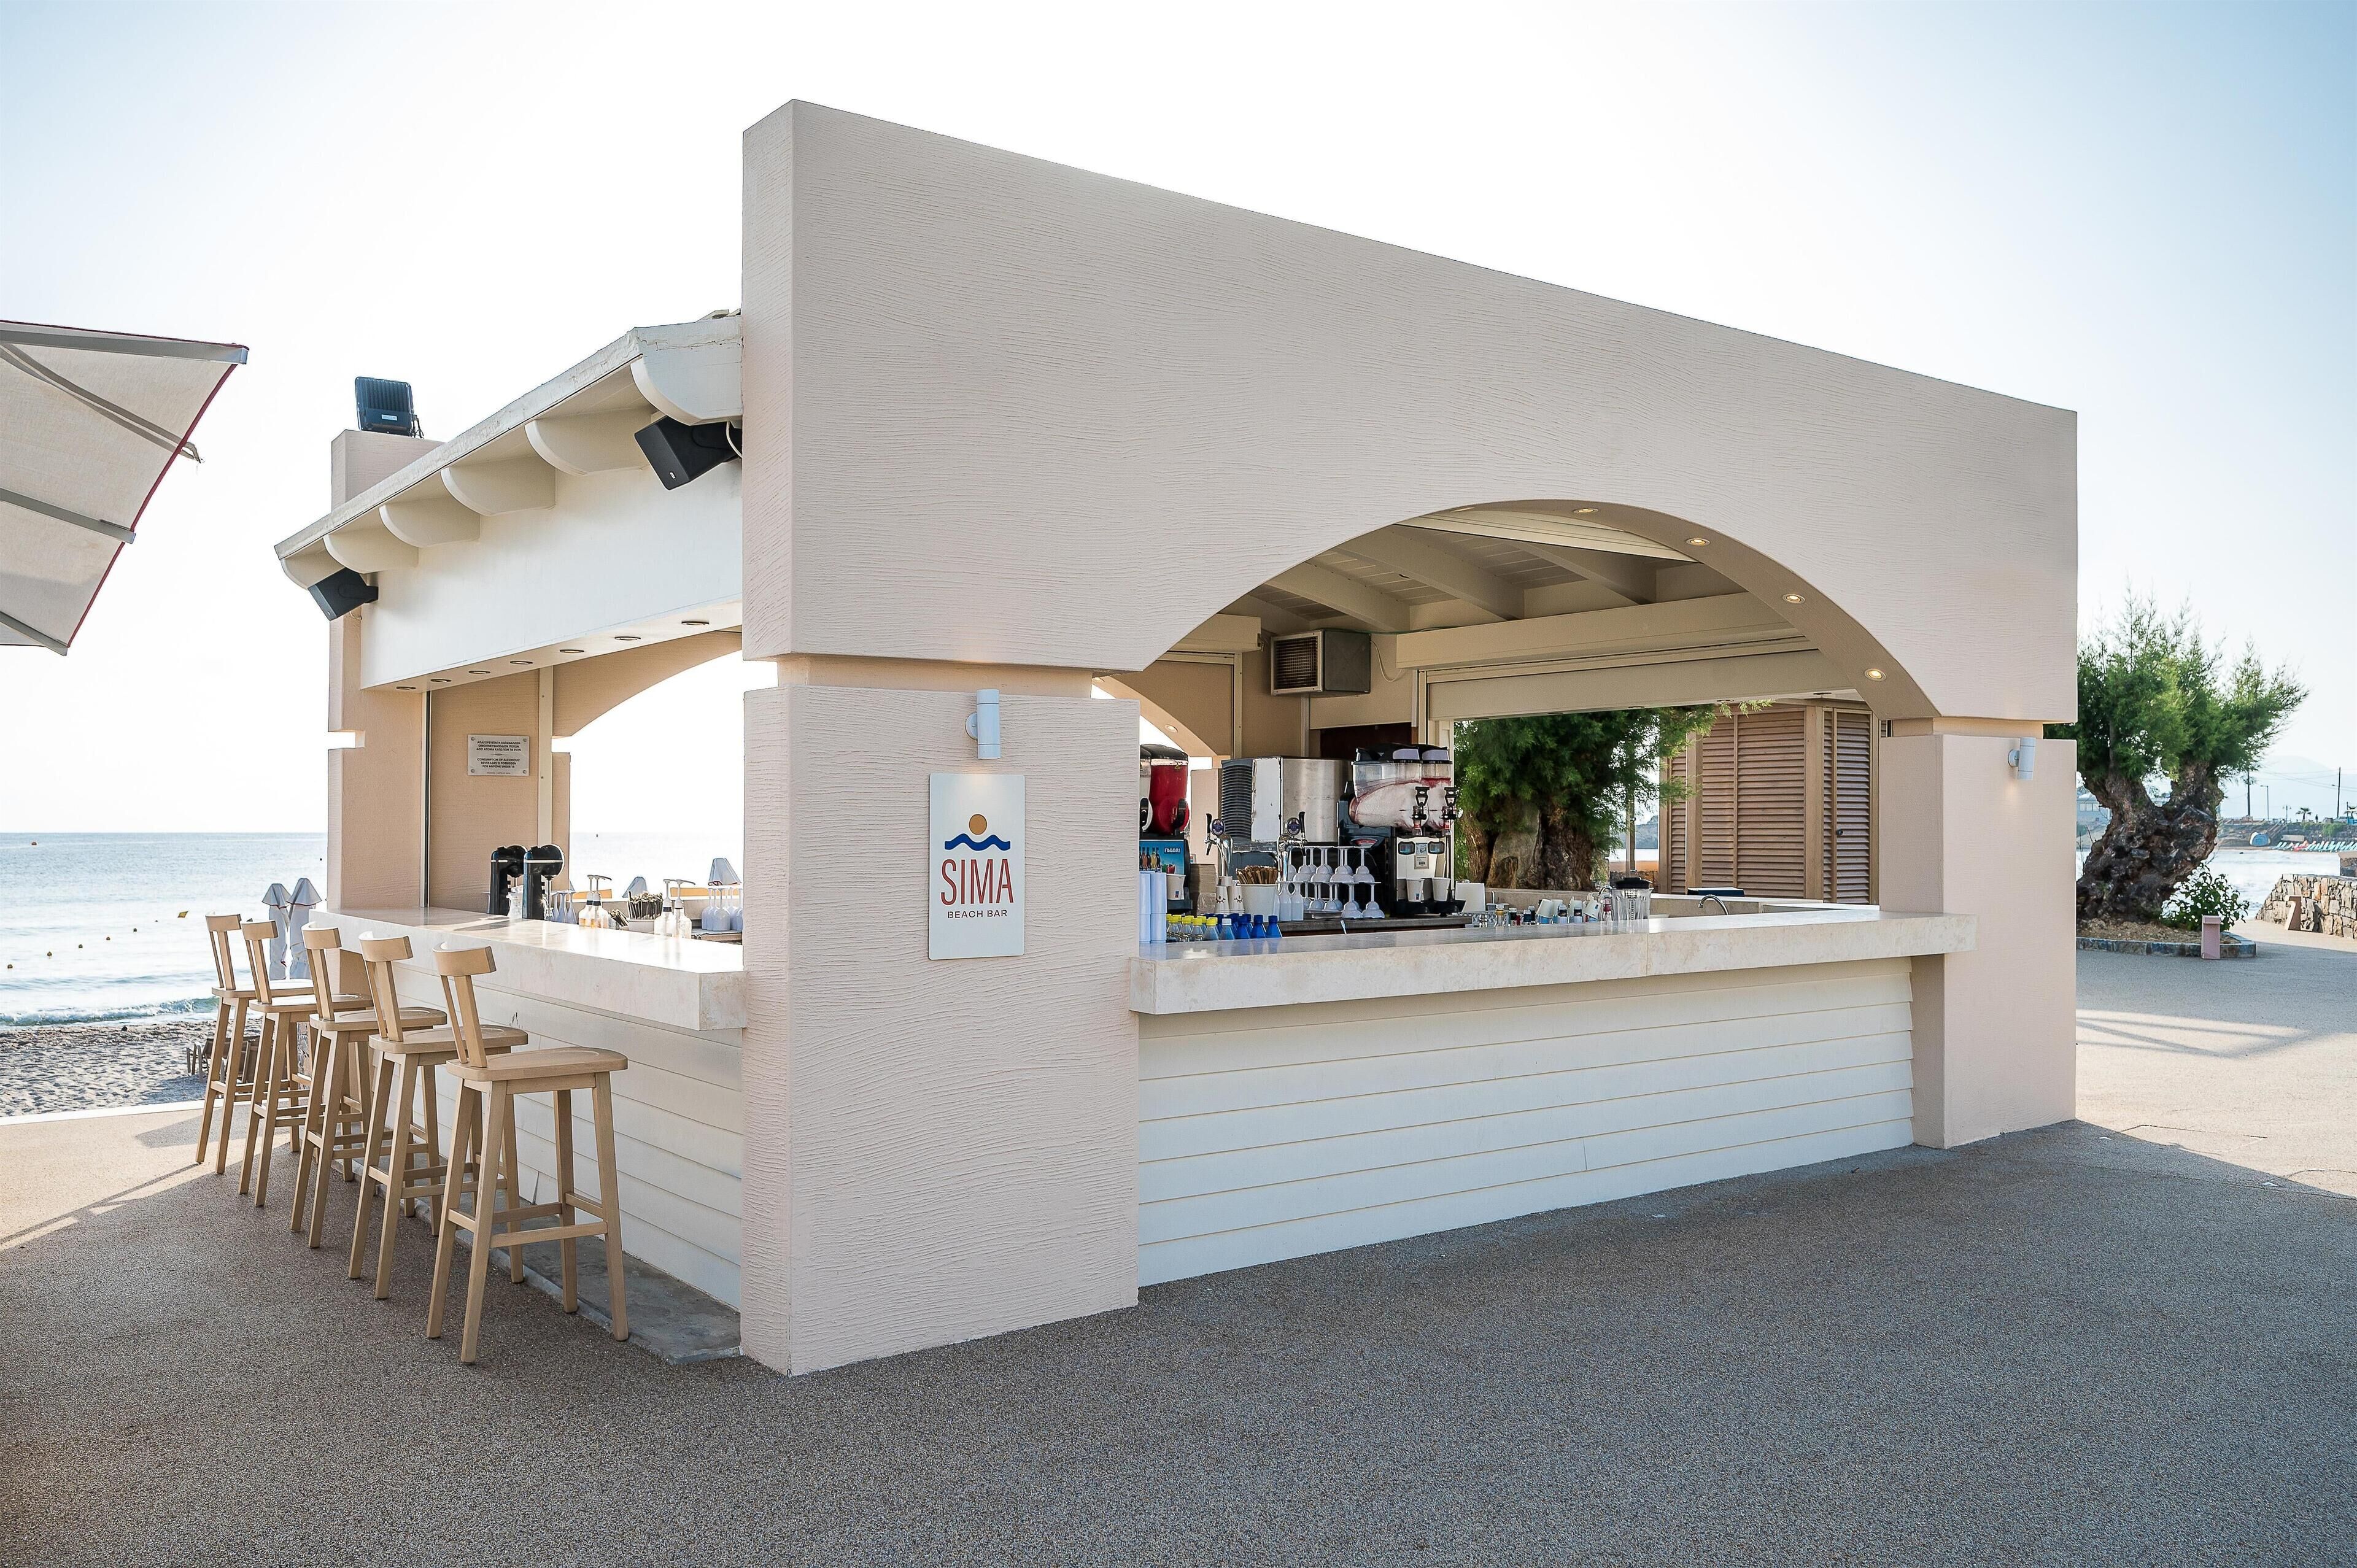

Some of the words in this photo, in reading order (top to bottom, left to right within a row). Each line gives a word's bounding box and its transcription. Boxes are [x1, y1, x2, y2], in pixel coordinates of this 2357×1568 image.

[940, 859, 1014, 906] SIMA
[947, 910, 983, 919] BEACH
[987, 909, 1007, 917] BAR
